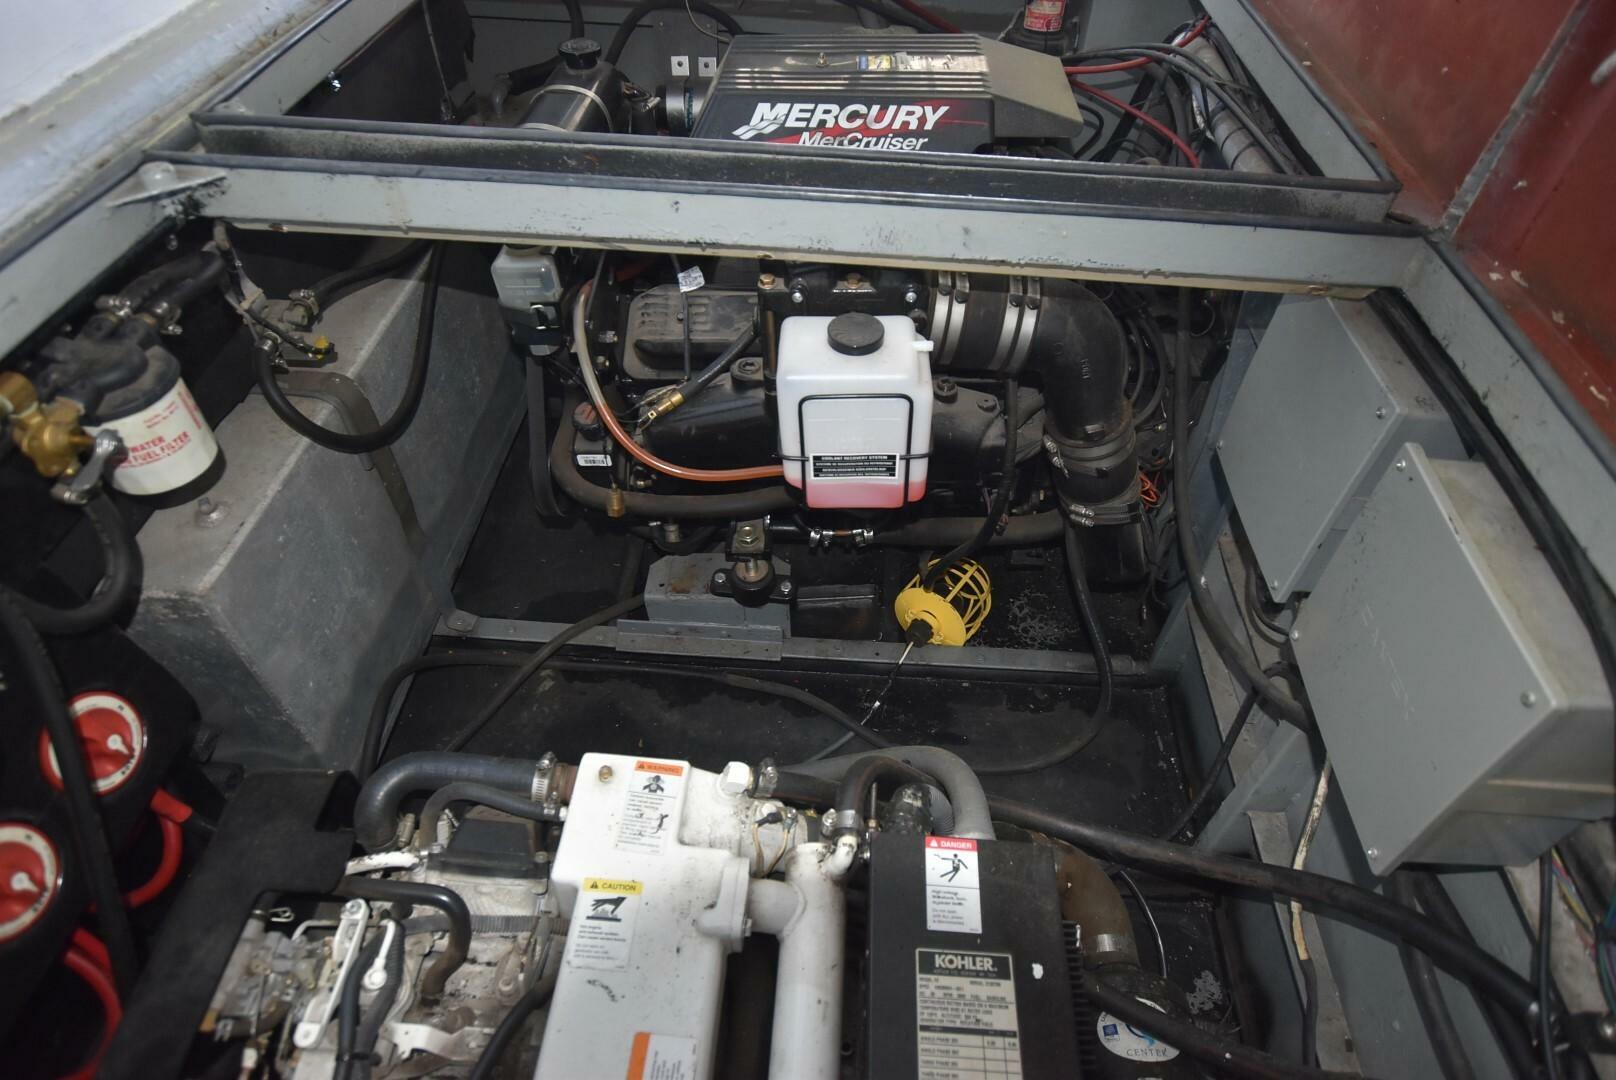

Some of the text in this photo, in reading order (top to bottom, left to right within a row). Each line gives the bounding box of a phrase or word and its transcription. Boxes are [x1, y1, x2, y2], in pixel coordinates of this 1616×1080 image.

[749, 103, 949, 130] MERCURY
[800, 131, 928, 150] MerCruiser
[130, 436, 165, 453] WATER
[133, 450, 160, 462] FUEL
[160, 431, 189, 453] FILTER
[646, 764, 680, 774] WARNING
[940, 840, 972, 849] DANGER
[601, 882, 637, 892] CAUTION
[934, 954, 993, 971] KOHLER
